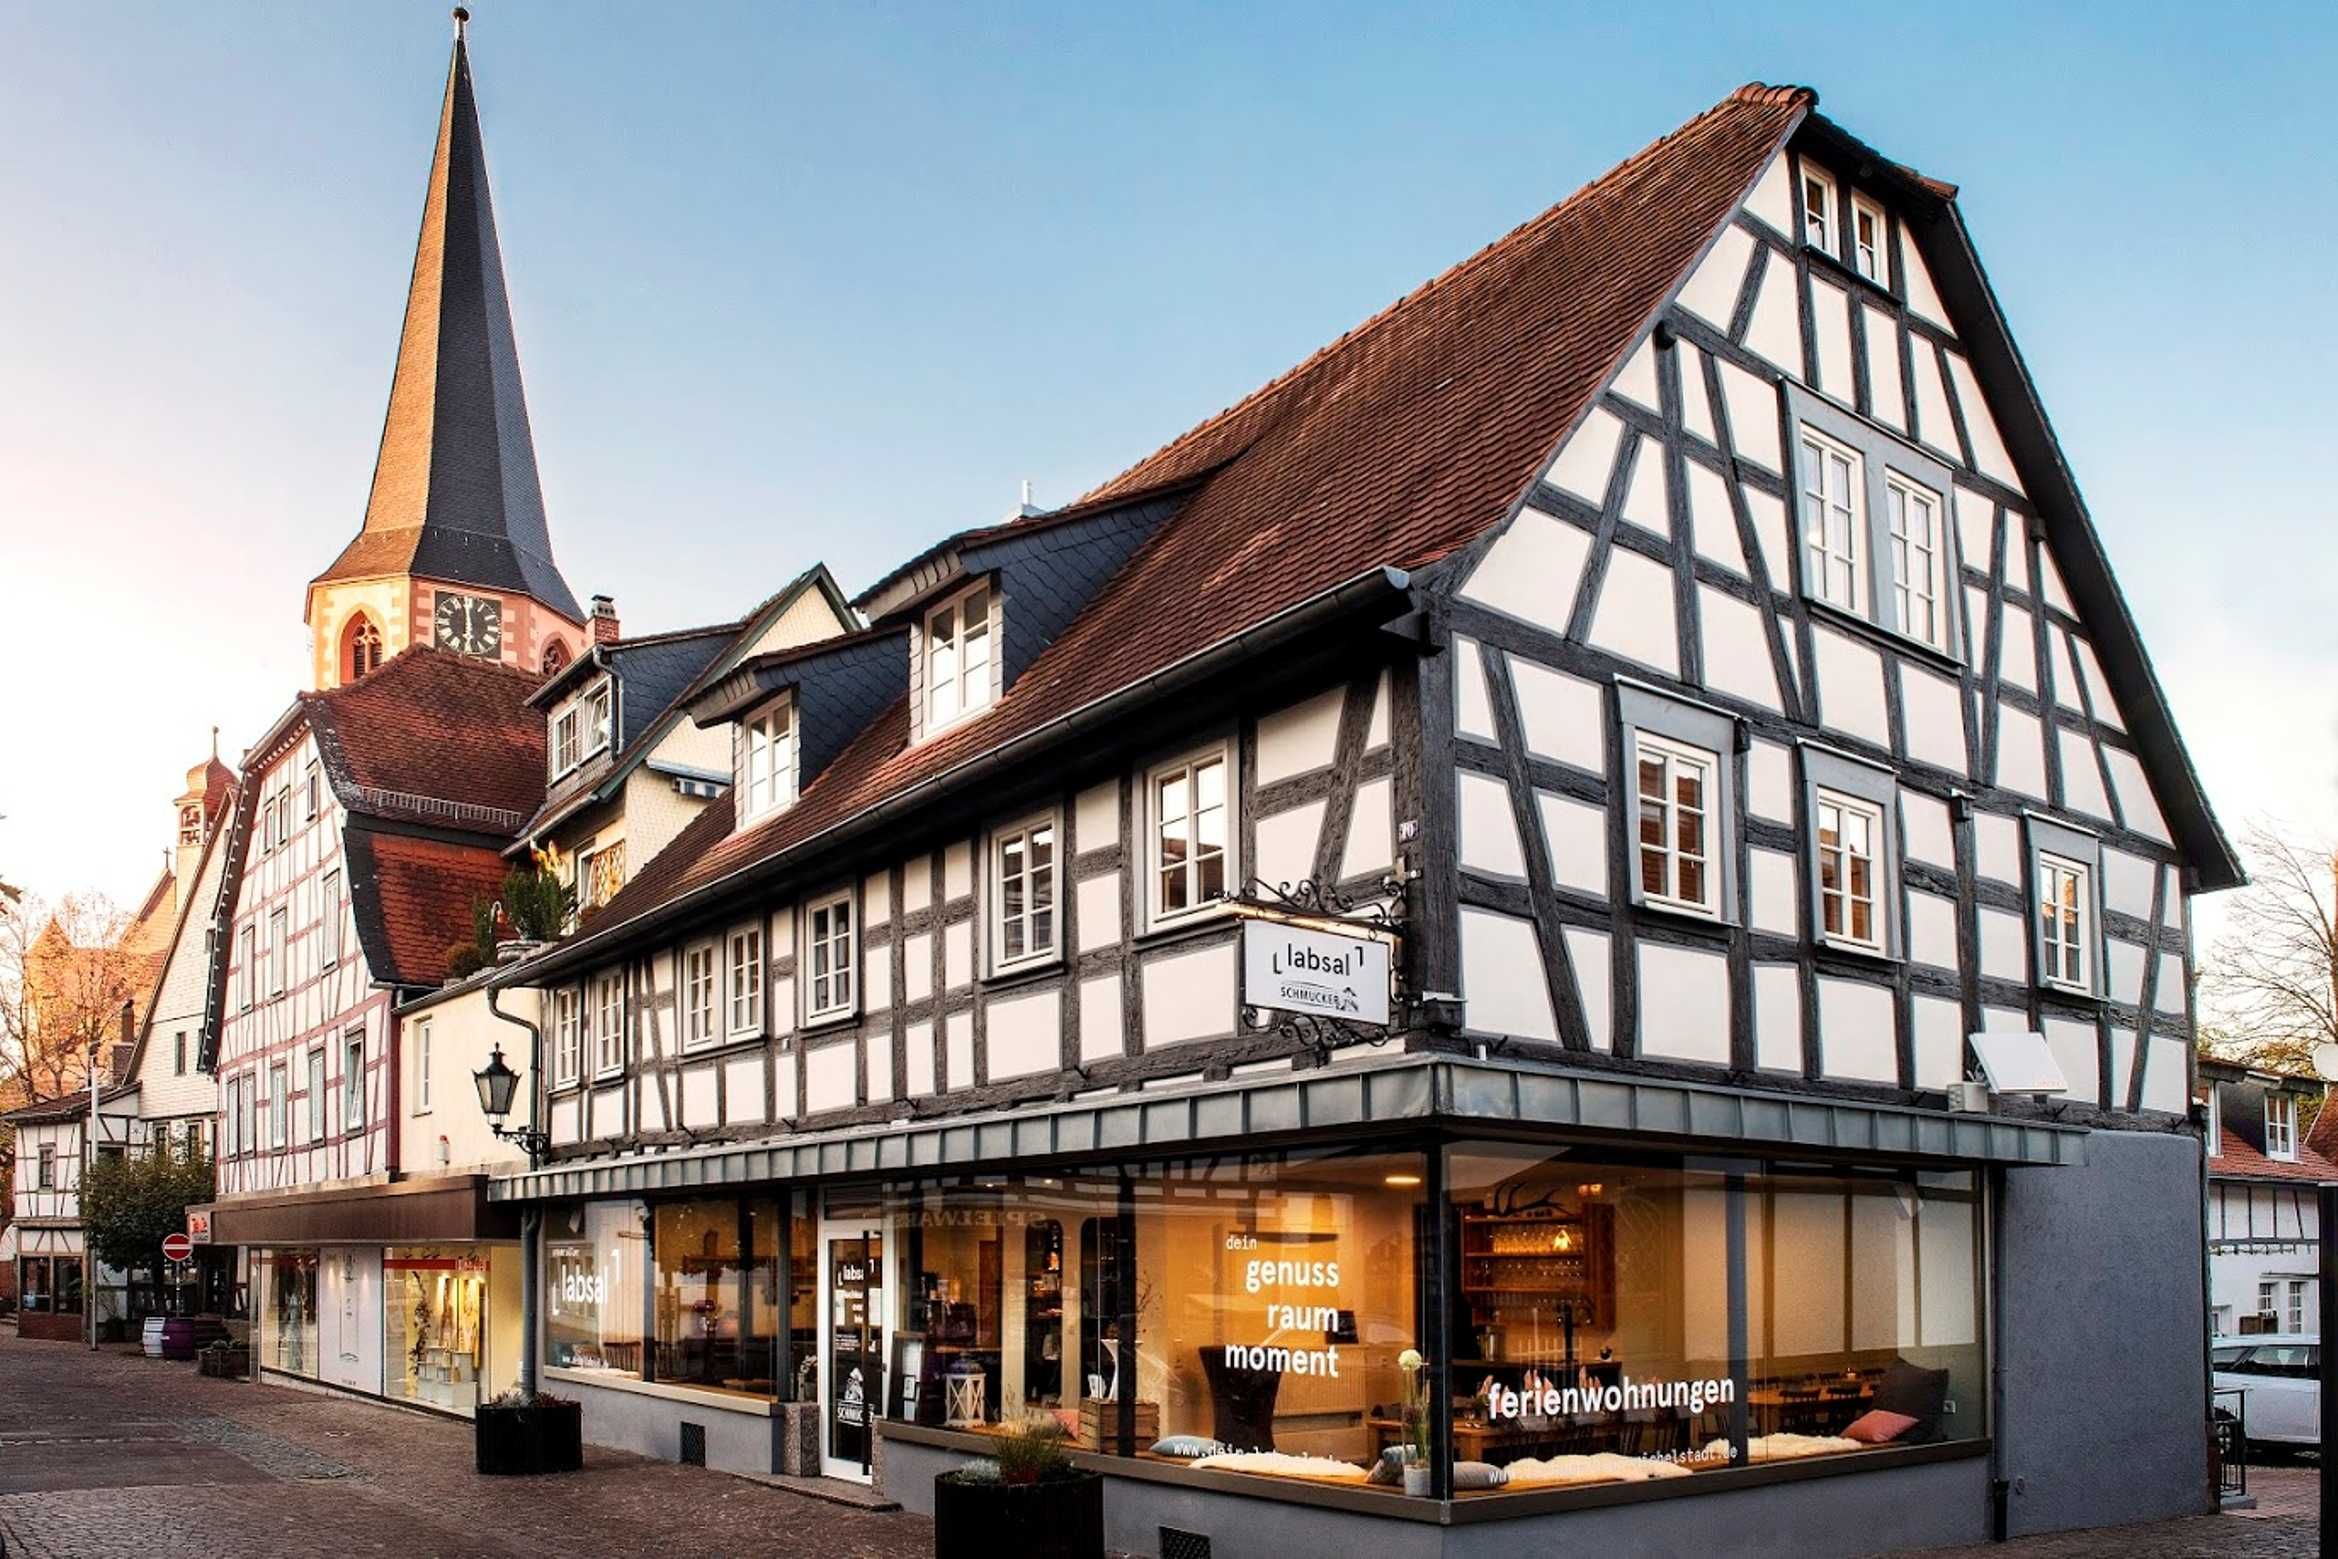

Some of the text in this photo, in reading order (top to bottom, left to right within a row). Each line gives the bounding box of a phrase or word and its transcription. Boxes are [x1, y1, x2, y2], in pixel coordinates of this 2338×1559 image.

[1287, 942, 1350, 977] labsal
[1280, 985, 1339, 1006] SCHMUCKER
[1225, 1234, 1258, 1251] dein
[561, 1263, 609, 1306] labsal
[1245, 1259, 1340, 1294] genuss
[1266, 1303, 1339, 1333] raum
[1225, 1343, 1340, 1379] moment
[1488, 1375, 1735, 1420] ferienwohnungen
